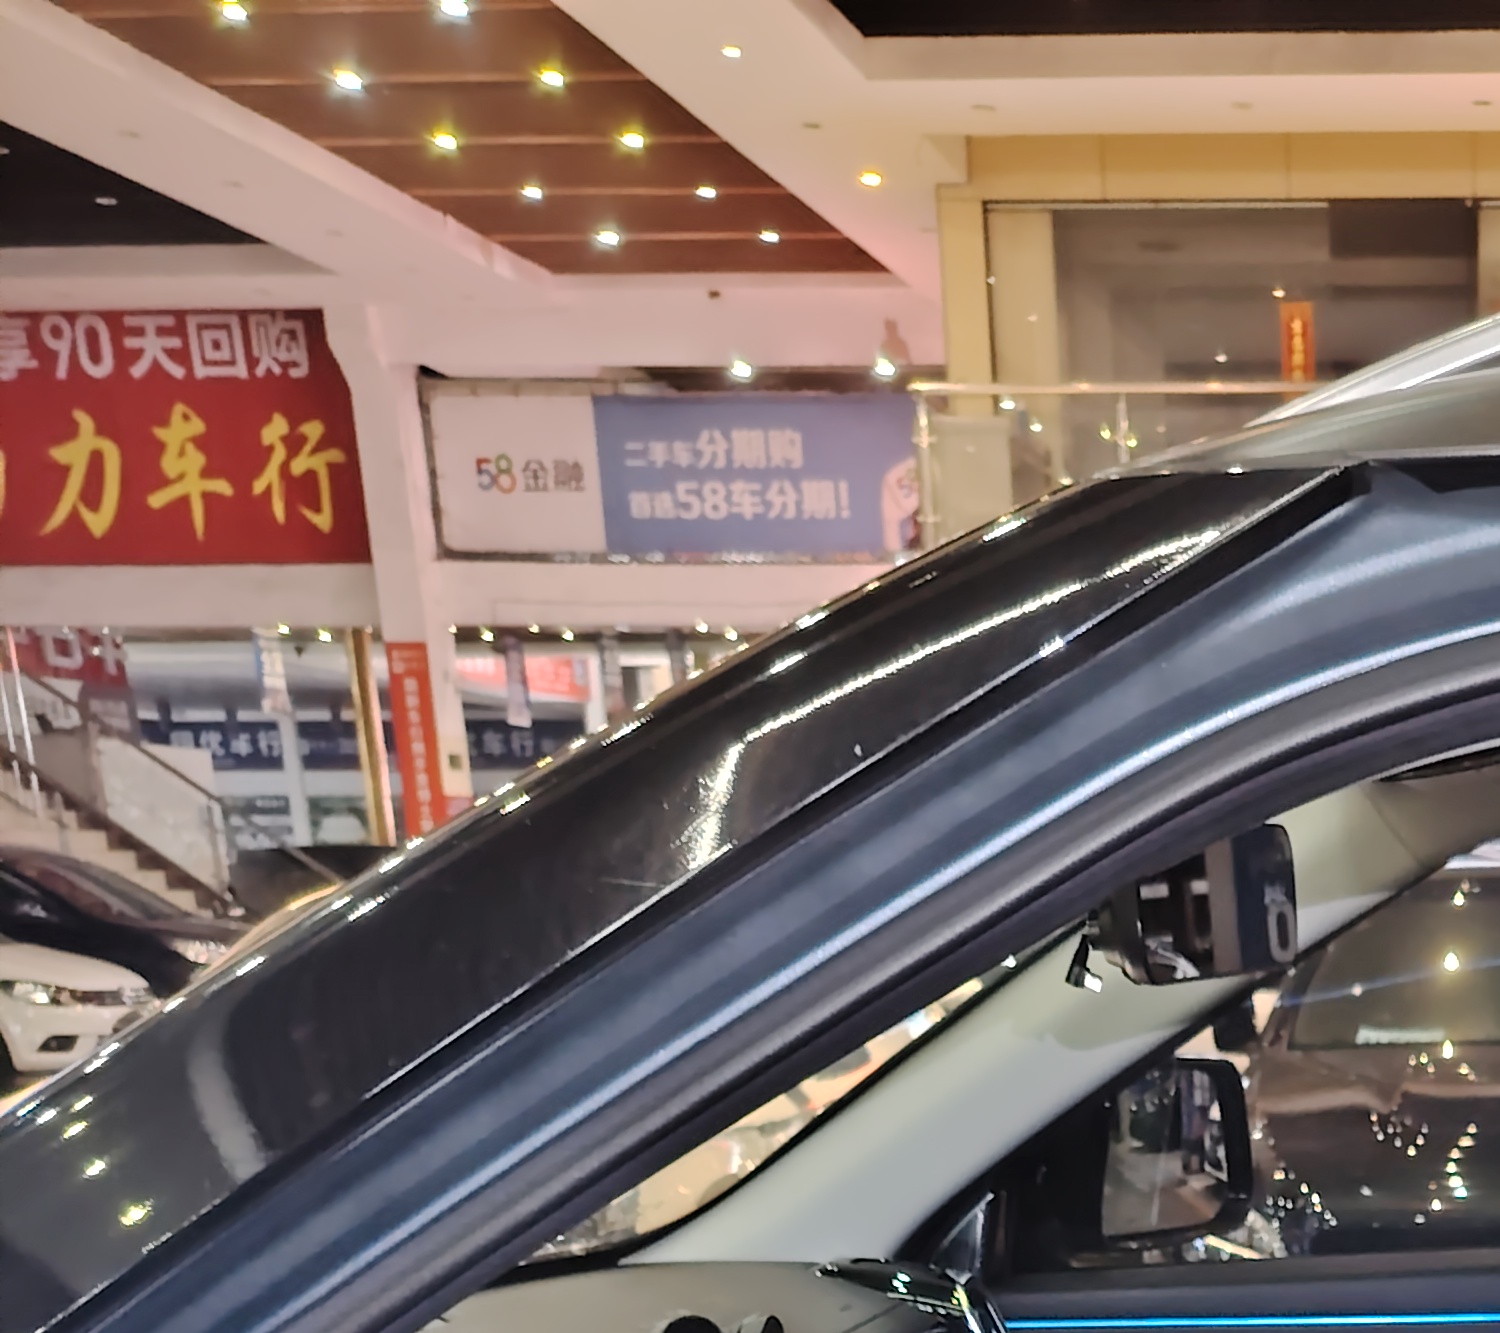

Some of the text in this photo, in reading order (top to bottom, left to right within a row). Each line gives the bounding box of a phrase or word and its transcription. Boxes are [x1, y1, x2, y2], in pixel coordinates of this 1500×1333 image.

[0, 401, 347, 541] 力车行
[475, 453, 587, 494] 58金融
